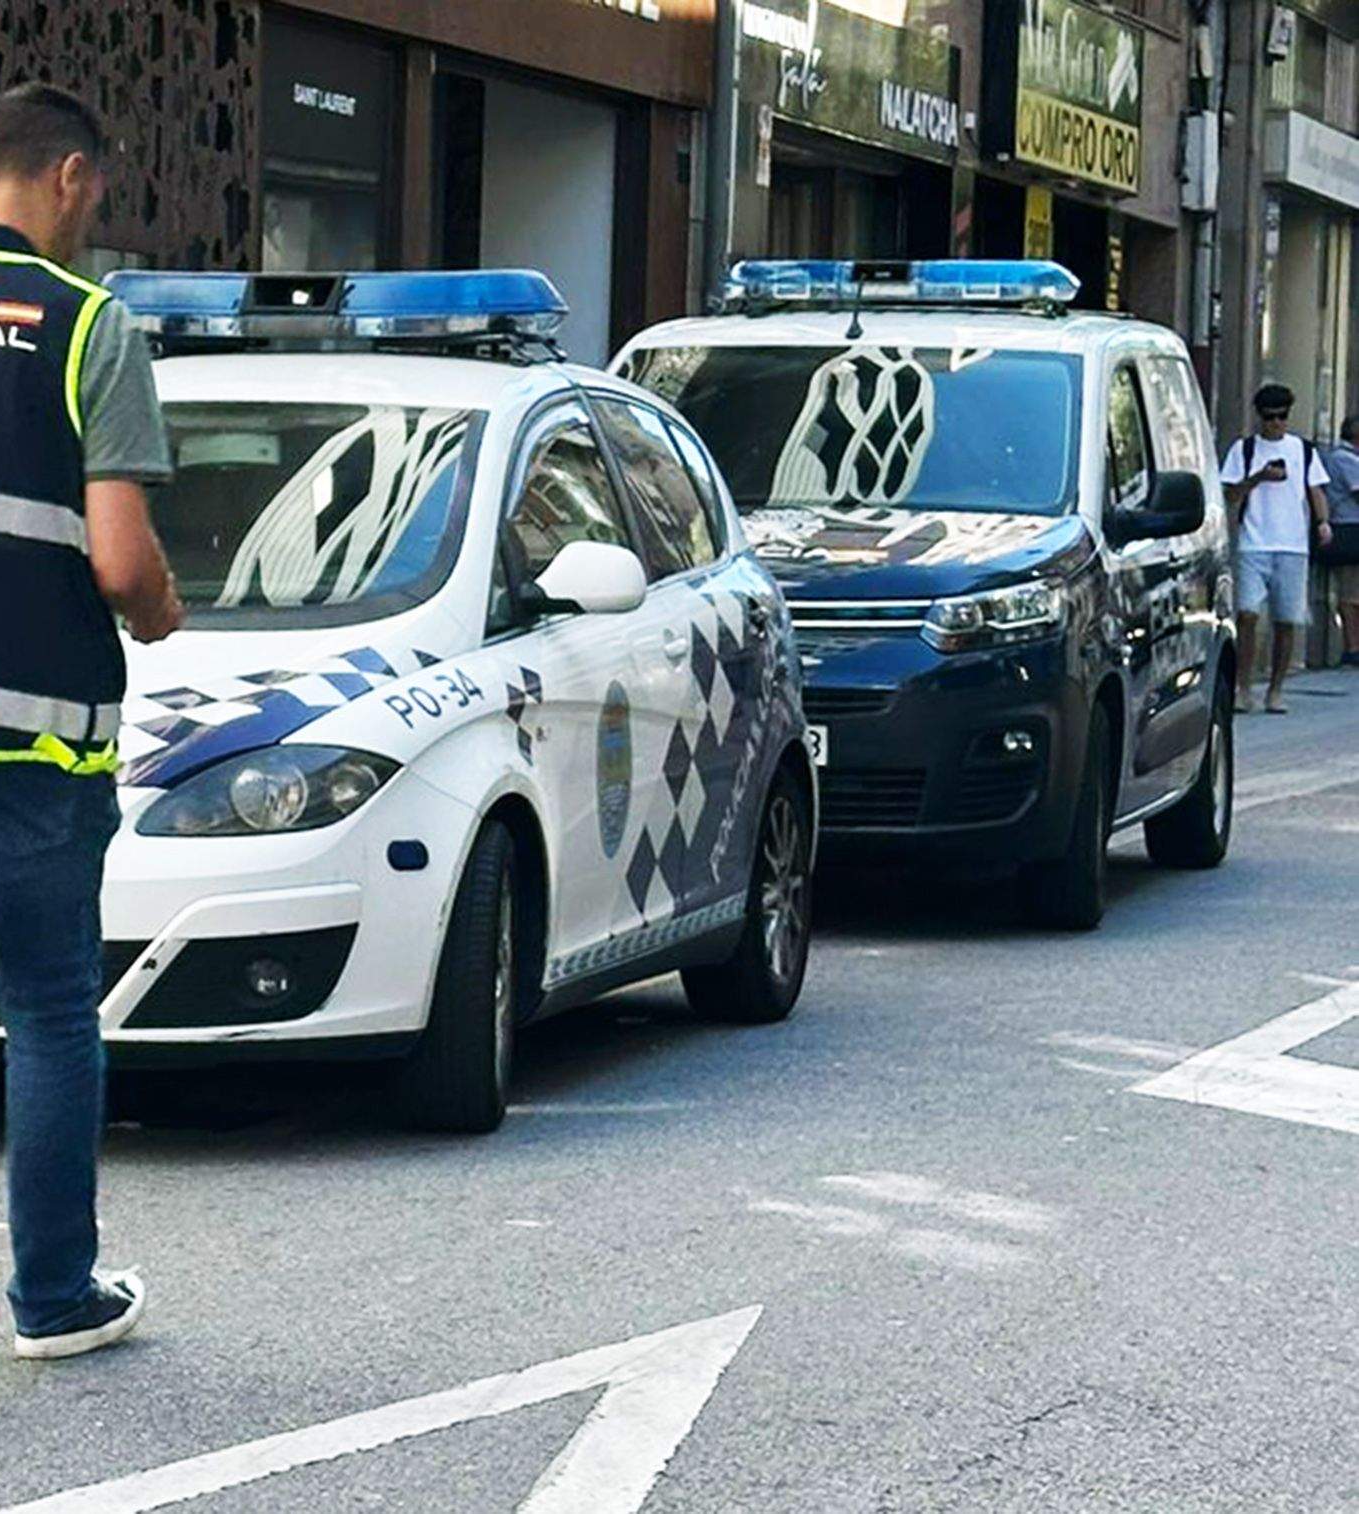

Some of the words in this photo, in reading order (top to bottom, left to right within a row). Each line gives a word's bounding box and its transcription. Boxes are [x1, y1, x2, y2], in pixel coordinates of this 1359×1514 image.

[1018, 101, 1097, 173] COMPRO
[1100, 124, 1136, 186] ORO
[384, 667, 485, 730] PO-34
